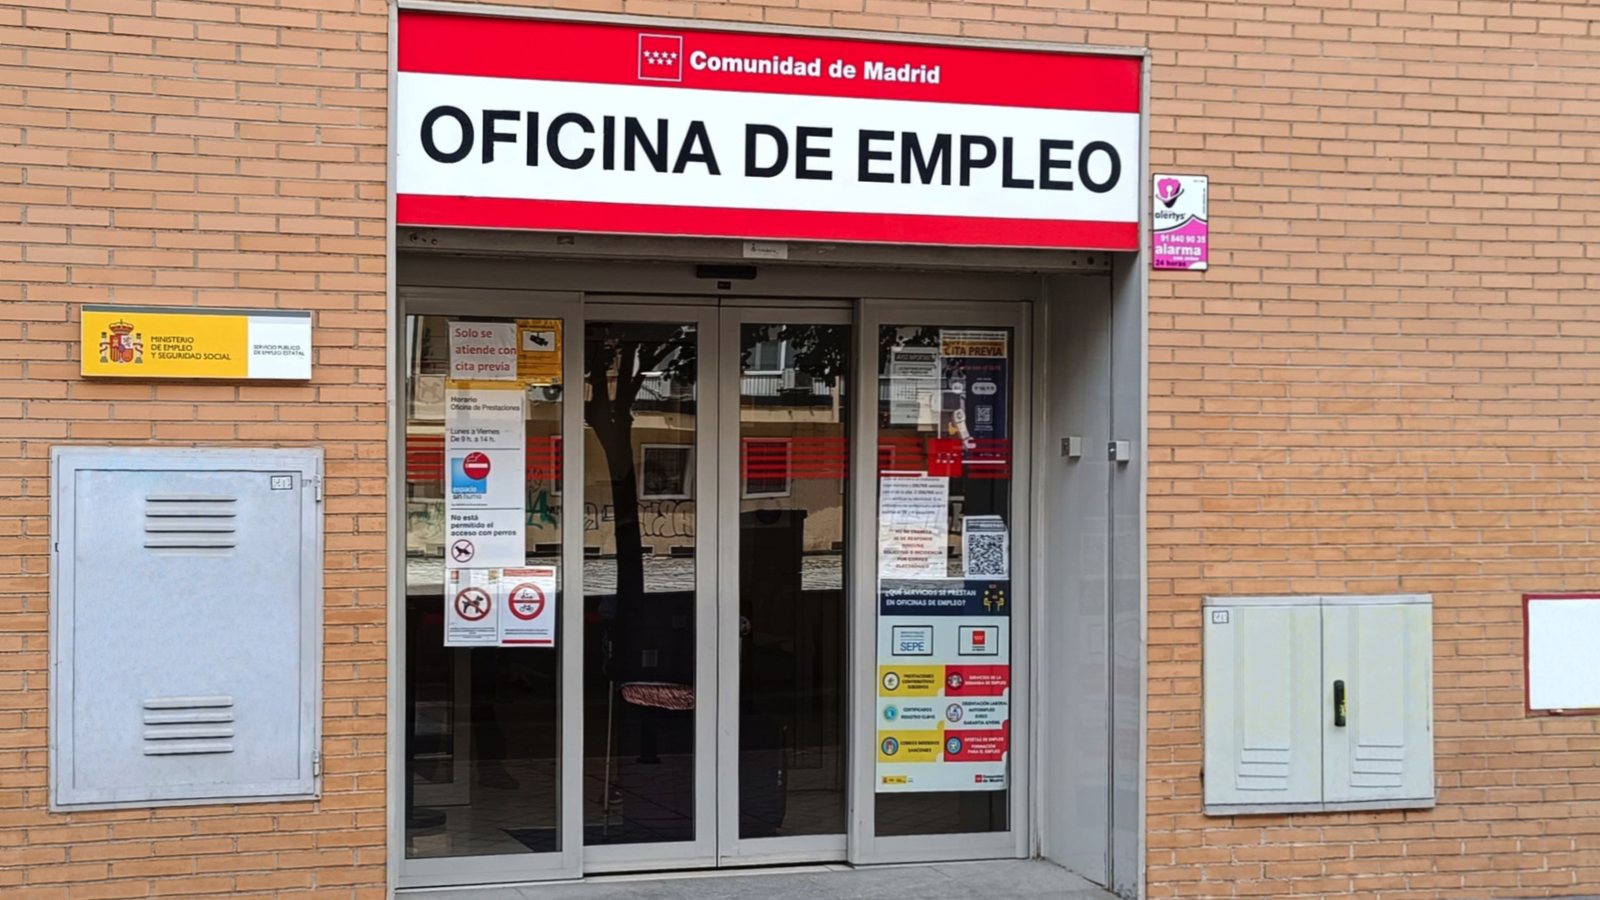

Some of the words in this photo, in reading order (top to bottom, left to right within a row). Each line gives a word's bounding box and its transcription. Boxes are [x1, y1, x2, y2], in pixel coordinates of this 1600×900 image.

[689, 49, 822, 78] Comunidad
[828, 60, 857, 79] de
[863, 60, 941, 85] Madrid
[420, 104, 721, 177] OFICINA
[744, 123, 834, 181] DE
[857, 129, 1122, 194] EMPLEO
[1155, 243, 1202, 256] alarma
[455, 328, 478, 338] Solo
[481, 330, 492, 338] se
[455, 345, 496, 355] atiende
[498, 346, 516, 355] con
[968, 347, 1003, 356] PREVIA
[158, 352, 202, 360] SEGURIDAD
[203, 352, 232, 360] SOCIAL
[456, 361, 474, 371] cita
[478, 362, 510, 372] previa
[900, 642, 924, 651] SEPE
